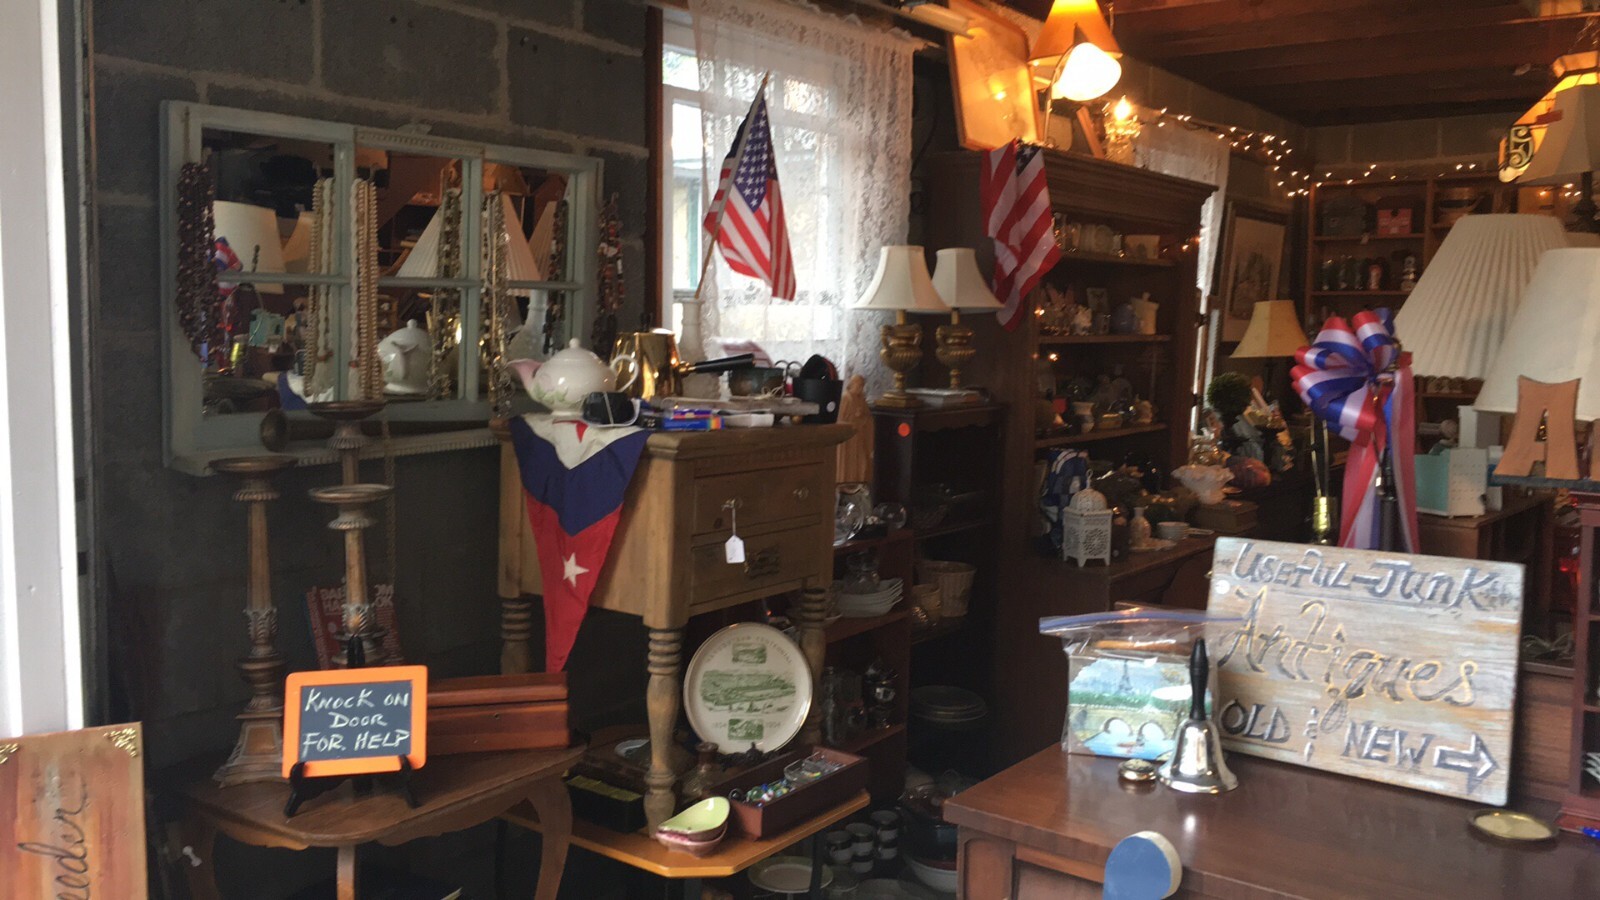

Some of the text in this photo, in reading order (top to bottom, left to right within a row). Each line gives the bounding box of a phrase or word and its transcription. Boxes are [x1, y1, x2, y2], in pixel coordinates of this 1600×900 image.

[305, 688, 409, 712] KNOCK ON
[328, 712, 388, 728] DOOR
[355, 729, 410, 751] HELP
[1220, 700, 1291, 743] OLD
[1342, 720, 1436, 769] NEW
